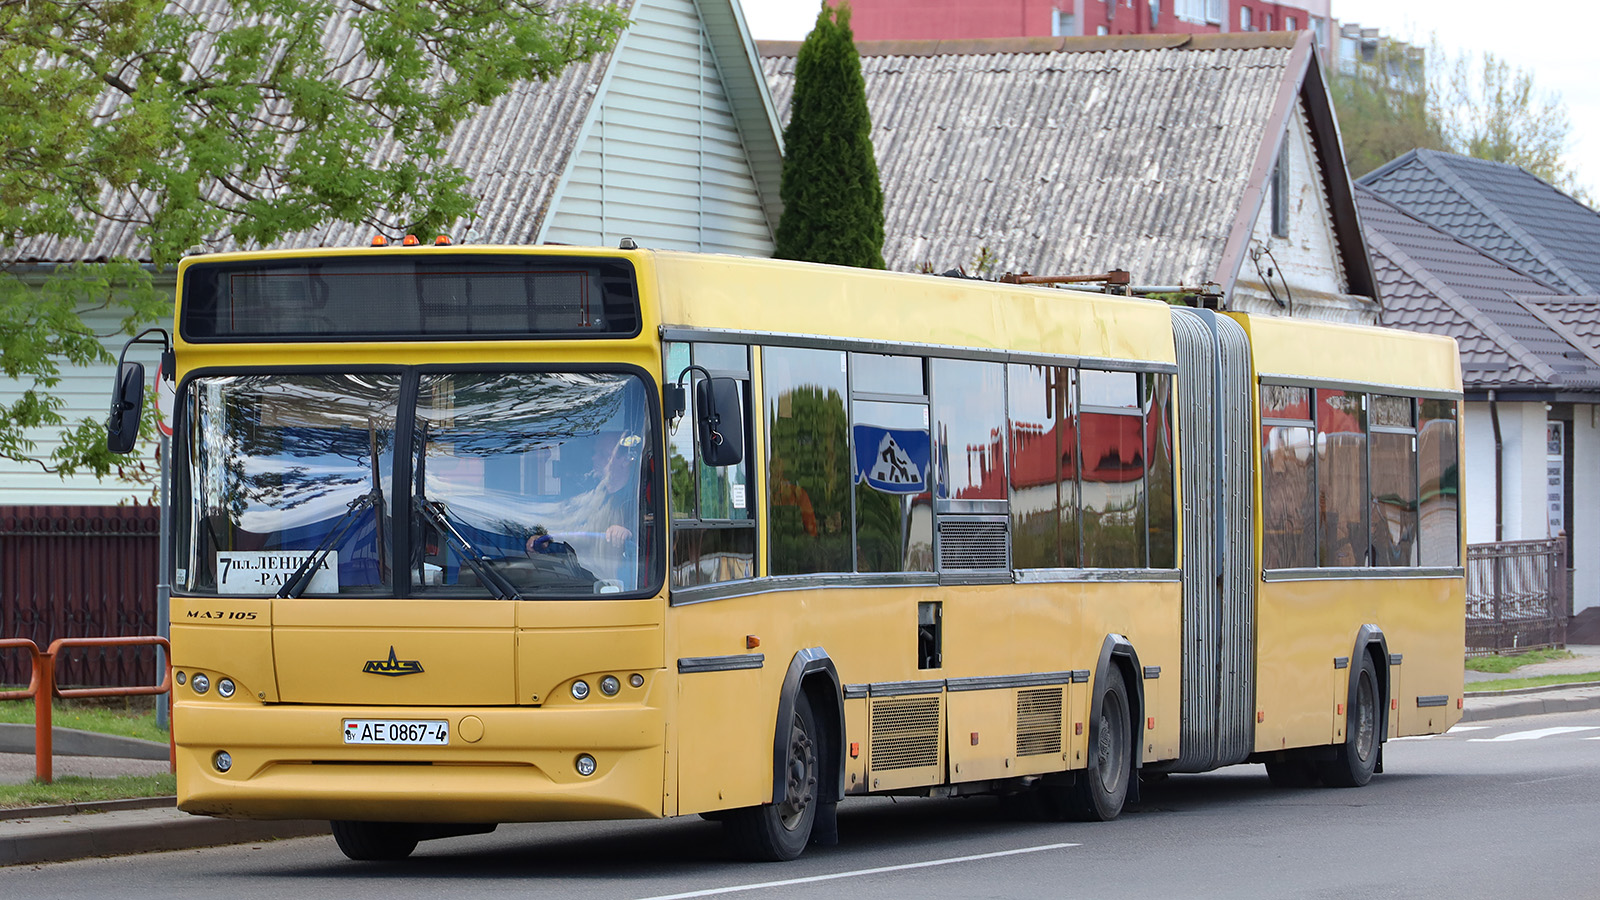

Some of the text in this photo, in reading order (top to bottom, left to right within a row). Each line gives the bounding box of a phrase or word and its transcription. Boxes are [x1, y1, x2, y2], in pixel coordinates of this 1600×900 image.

[220, 558, 232, 584] 7
[186, 610, 258, 620] МАЗ 105
[347, 723, 445, 742] BY AE 0867-4
